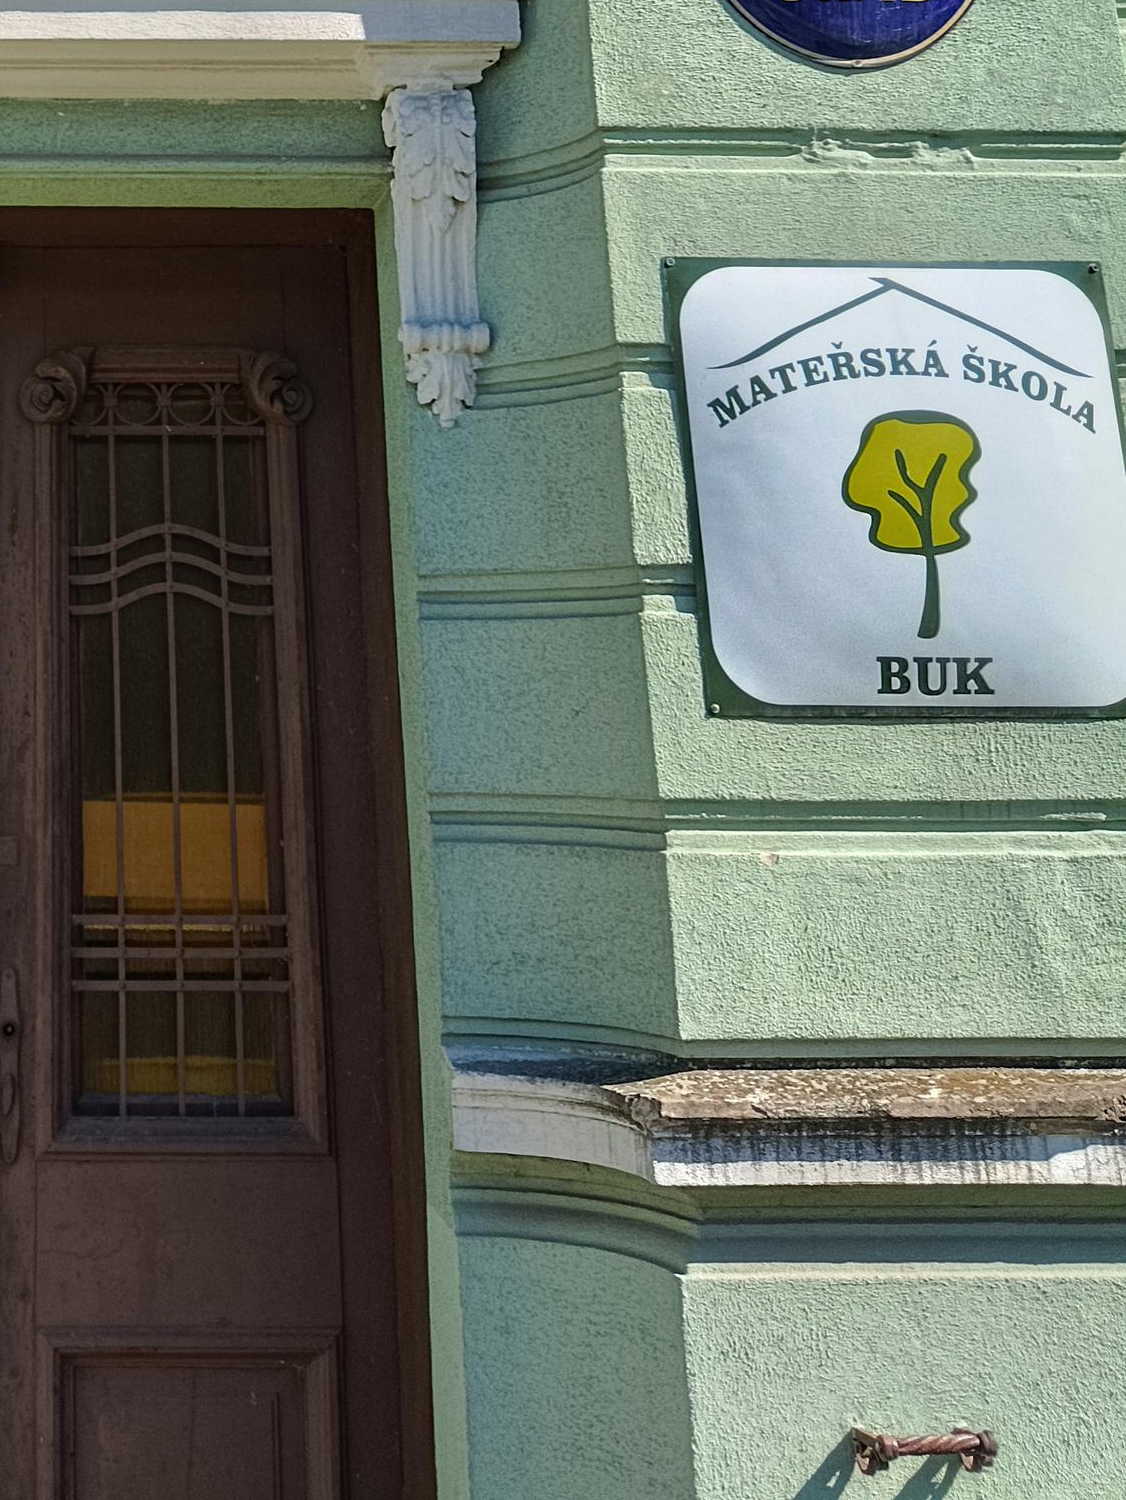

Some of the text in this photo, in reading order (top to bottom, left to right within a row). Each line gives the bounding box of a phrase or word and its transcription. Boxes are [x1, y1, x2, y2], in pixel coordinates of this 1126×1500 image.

[707, 340, 1098, 435] MATEŘSKÁ ŠKOLA
[876, 656, 996, 697] BUK
